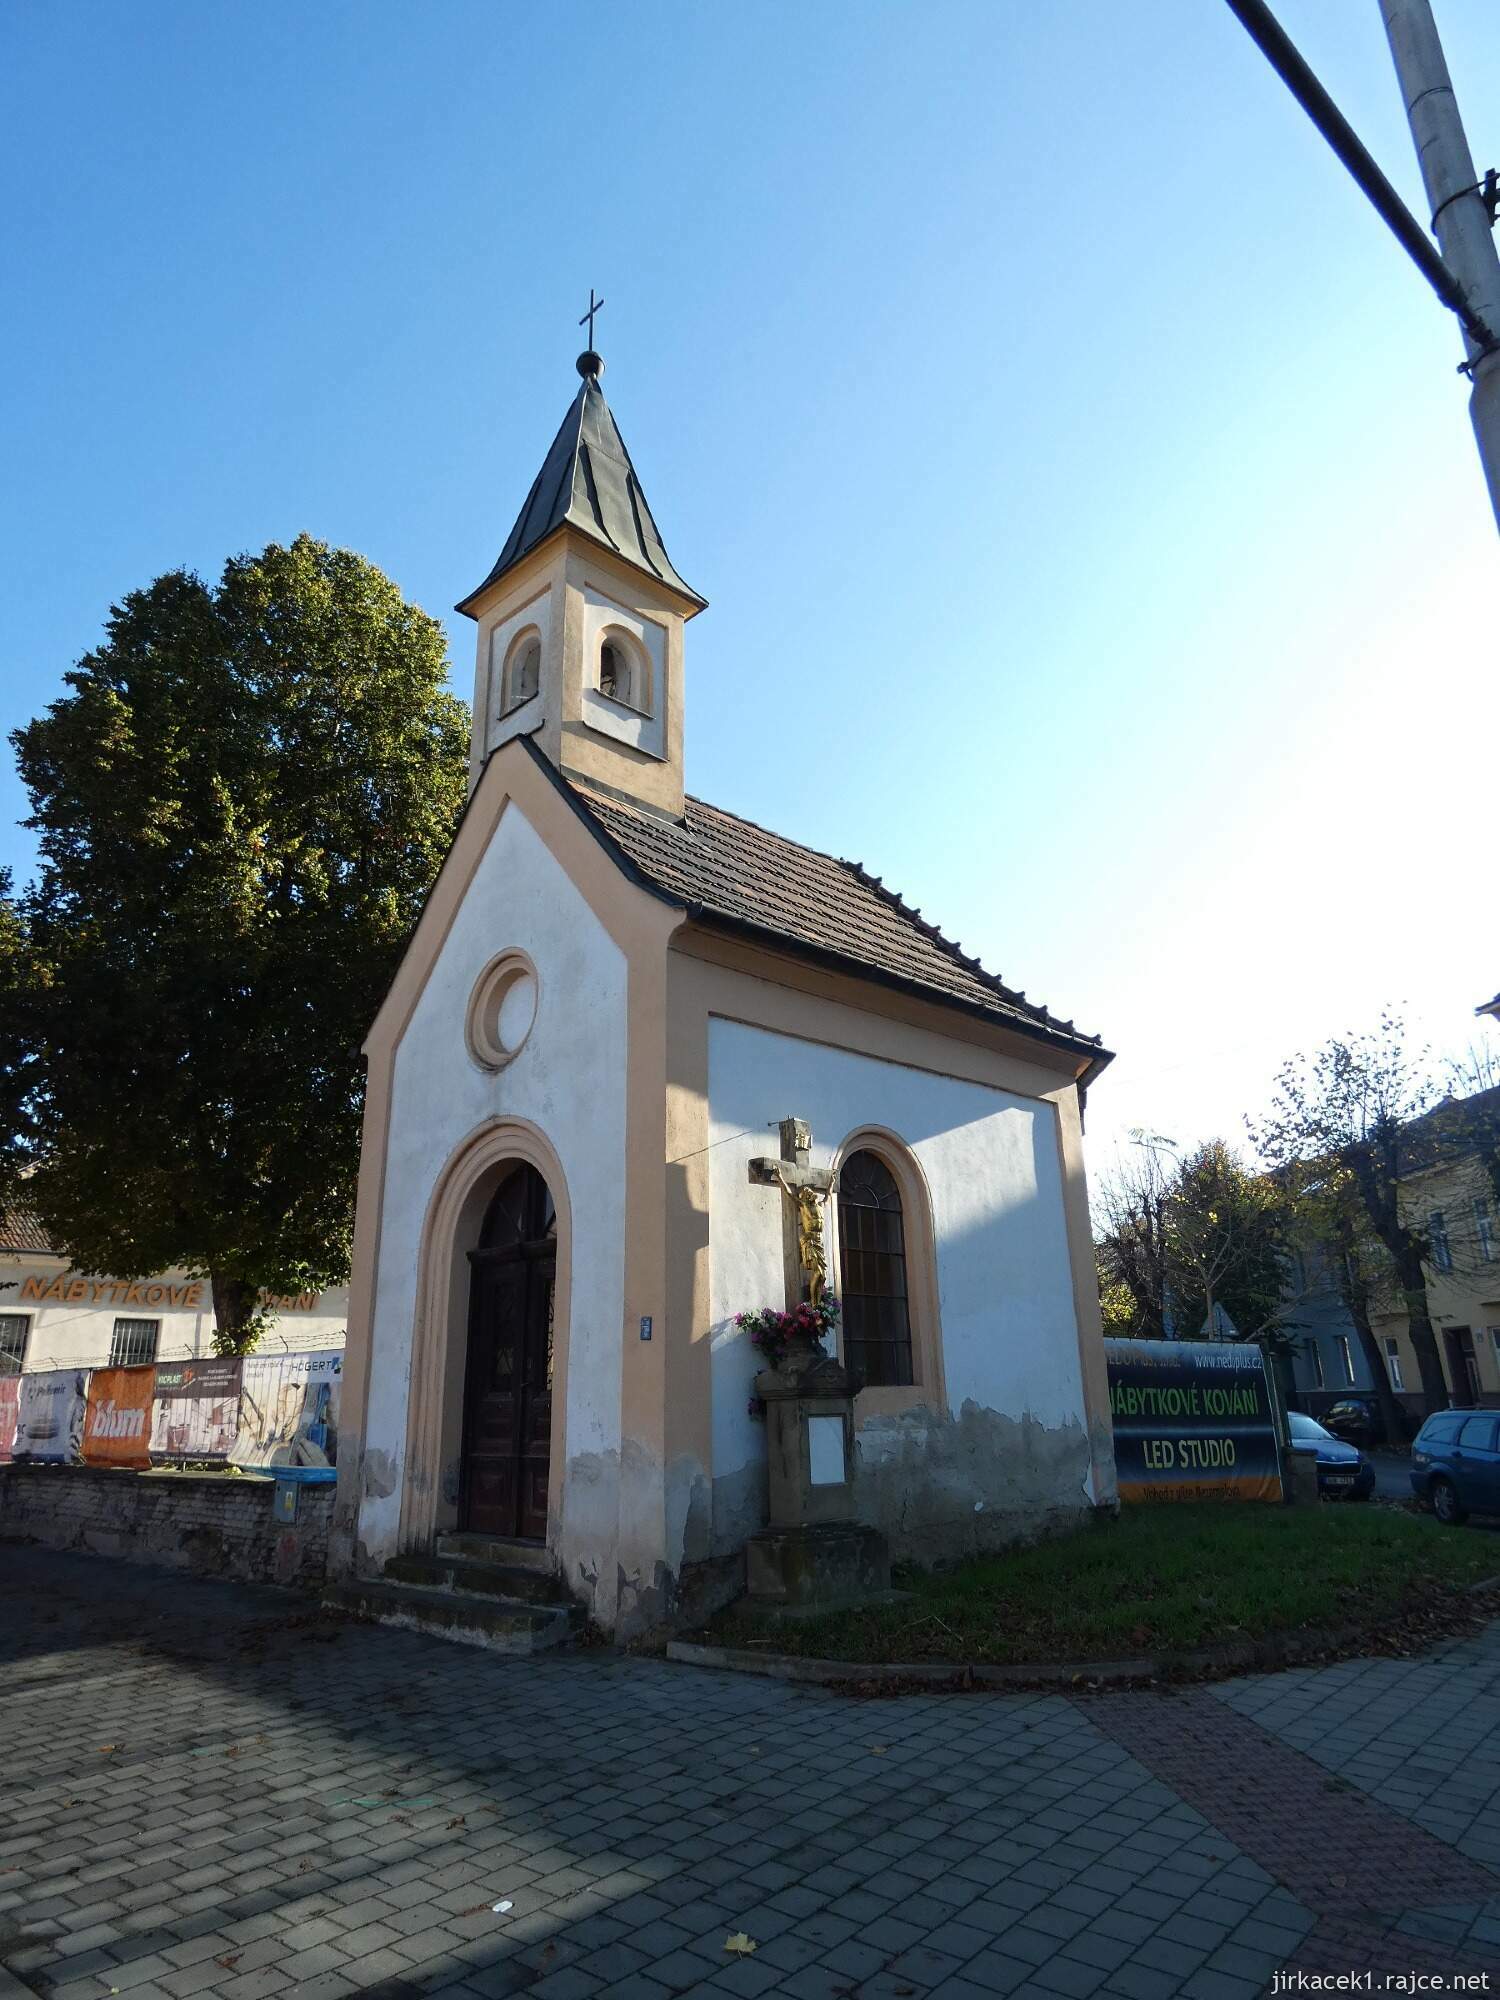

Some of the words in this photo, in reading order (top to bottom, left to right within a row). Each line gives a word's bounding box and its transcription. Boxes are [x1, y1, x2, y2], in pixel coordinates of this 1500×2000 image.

[20, 1272, 206, 1308] NÁBYTKOVÉ
[1110, 1379, 1200, 1416] NÁBYTKOVÉ
[1203, 1382, 1260, 1416] KOVÁNÍ
[92, 1400, 146, 1438] blum
[1142, 1440, 1174, 1469] LED
[1179, 1438, 1236, 1468] STUDIO
